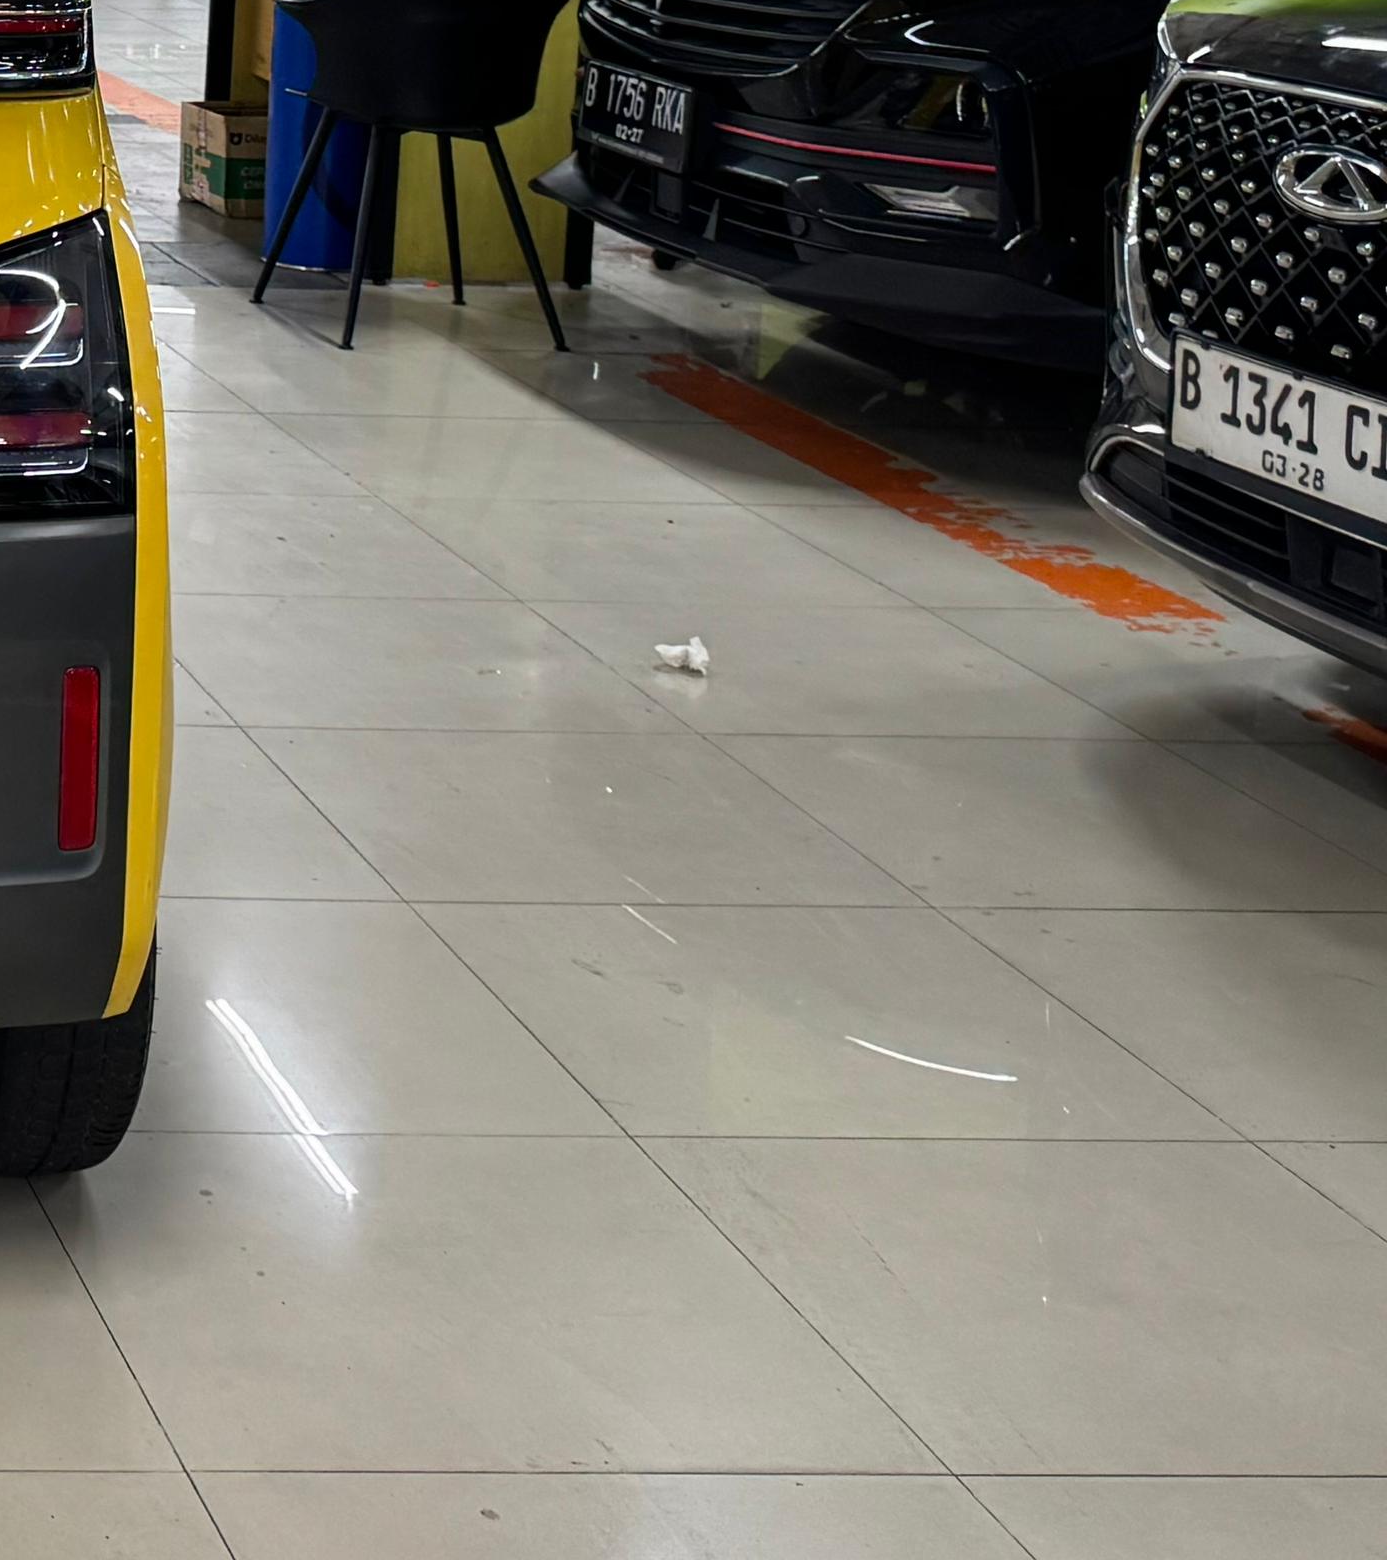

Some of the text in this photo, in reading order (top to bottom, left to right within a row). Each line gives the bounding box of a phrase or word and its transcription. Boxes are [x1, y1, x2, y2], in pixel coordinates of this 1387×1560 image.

[584, 66, 686, 136] B 1756 RKA
[1179, 348, 1202, 410] B
[1220, 364, 1318, 455] 1341
